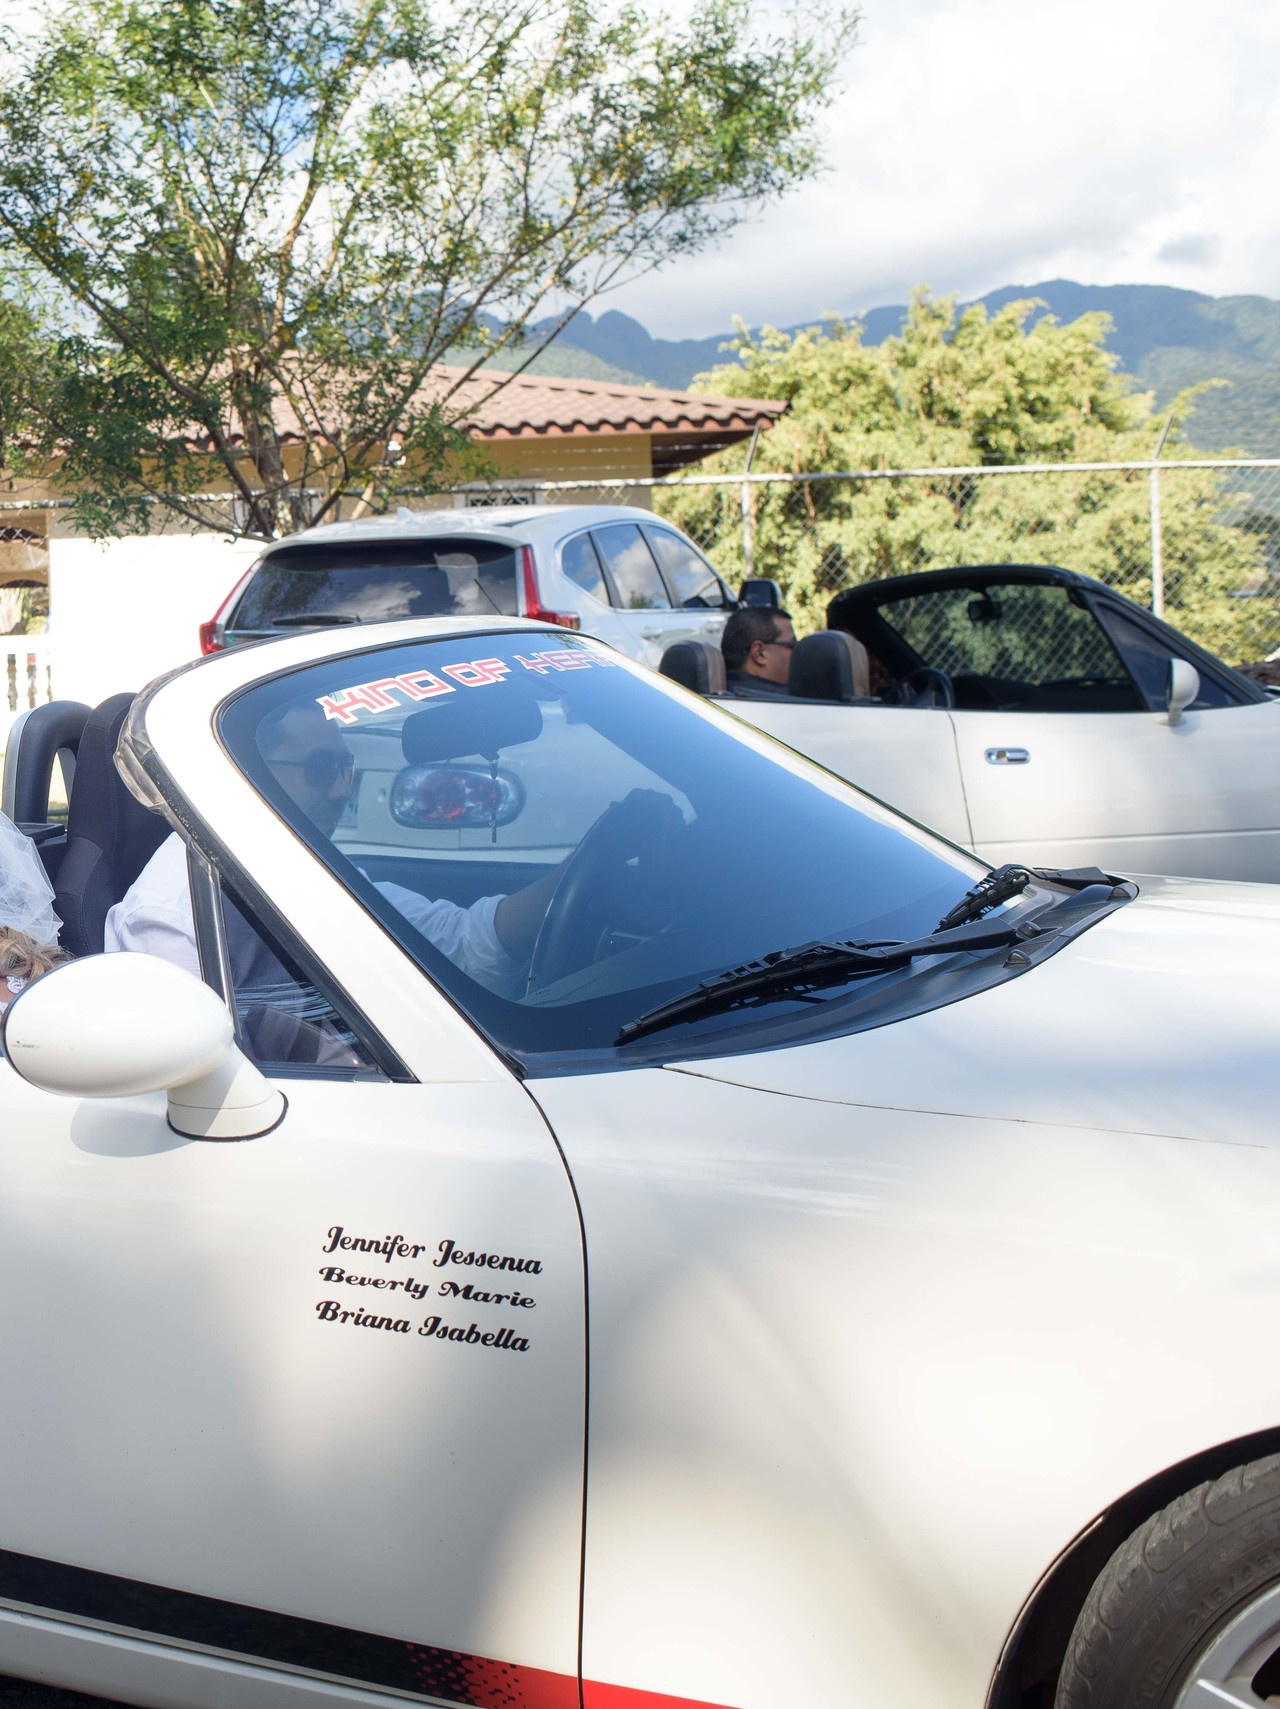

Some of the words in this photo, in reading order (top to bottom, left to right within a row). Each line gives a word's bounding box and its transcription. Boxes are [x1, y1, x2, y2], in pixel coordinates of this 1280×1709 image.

[316, 670, 456, 724] KING
[441, 658, 512, 687] OF
[322, 1226, 426, 1263] Jennifer
[318, 1266, 429, 1299] Beverly
[437, 1281, 537, 1309] Marie
[315, 1300, 412, 1334] Briana
[417, 1315, 531, 1352] Isabella
